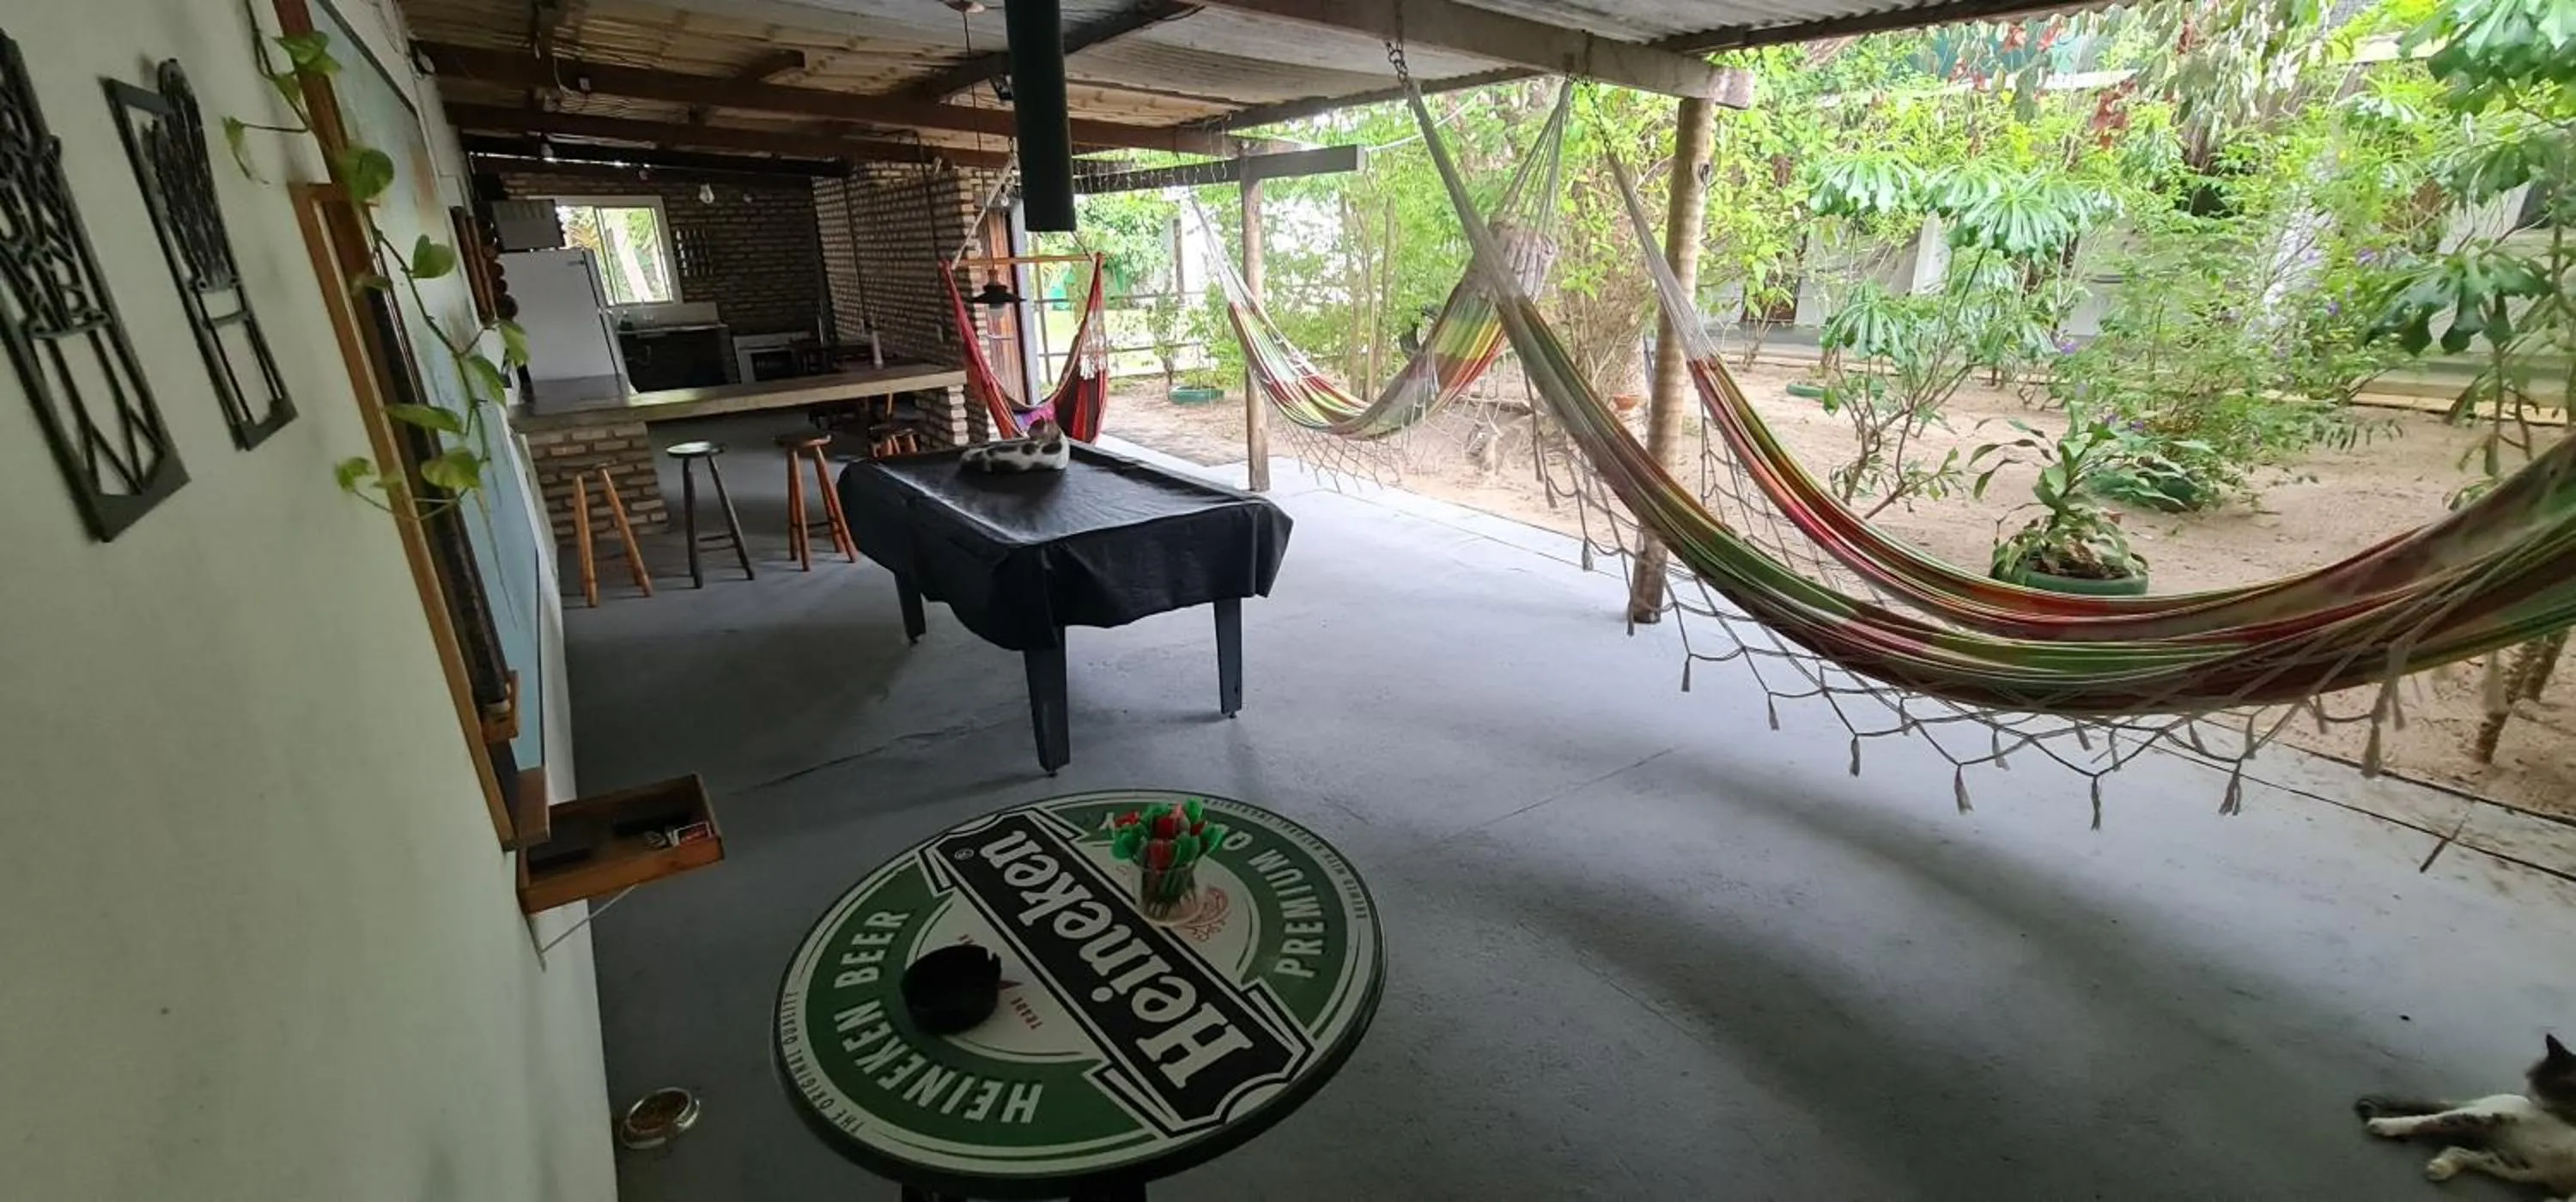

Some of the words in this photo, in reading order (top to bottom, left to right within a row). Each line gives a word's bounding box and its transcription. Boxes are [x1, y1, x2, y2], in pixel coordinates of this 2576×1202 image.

[835, 908, 908, 989] BEER
[1249, 847, 1323, 980] PREMIUM
[980, 829, 1254, 1090] Heineken
[1010, 997, 1042, 1030] TRADE
[787, 1049, 835, 1110] ORIGINAL
[835, 1004, 1043, 1124] HEINEKEN
[831, 1109, 865, 1134] THE
